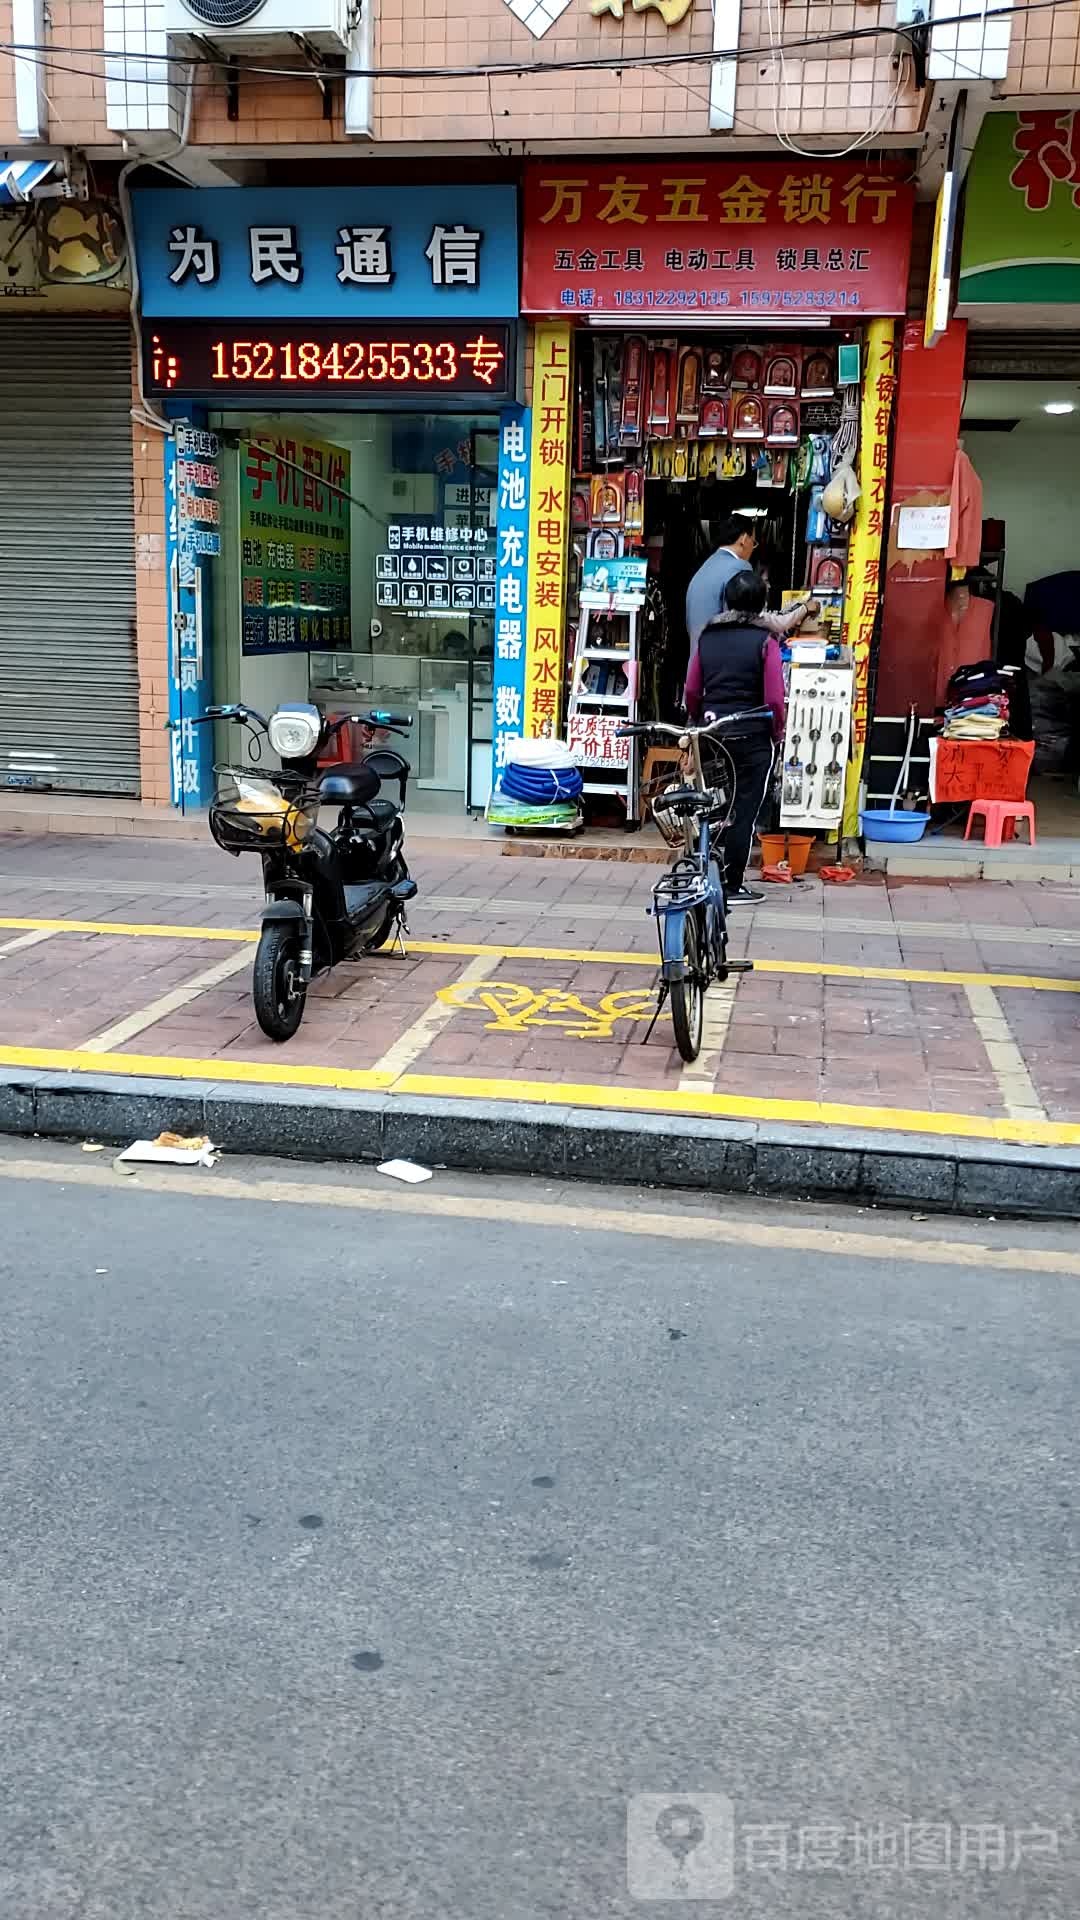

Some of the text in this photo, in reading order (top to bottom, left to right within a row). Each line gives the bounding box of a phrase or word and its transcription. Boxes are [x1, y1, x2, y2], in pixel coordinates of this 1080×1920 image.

[539, 174, 897, 224] 万友五金锁行
[169, 226, 480, 283] 为民通信
[554, 249, 870, 271] 五金工具 电动工具 锁具总汇
[539, 341, 567, 466] 上门开锁
[246, 432, 346, 518] 手机配件
[500, 420, 527, 510] 电池
[242, 537, 263, 567] 电池
[267, 540, 296, 569] 充电器
[401, 526, 488, 542] 手机维修中心
[535, 486, 563, 608] 水电安装
[496, 526, 525, 660] 充电器
[568, 737, 630, 760] 厂价直销
